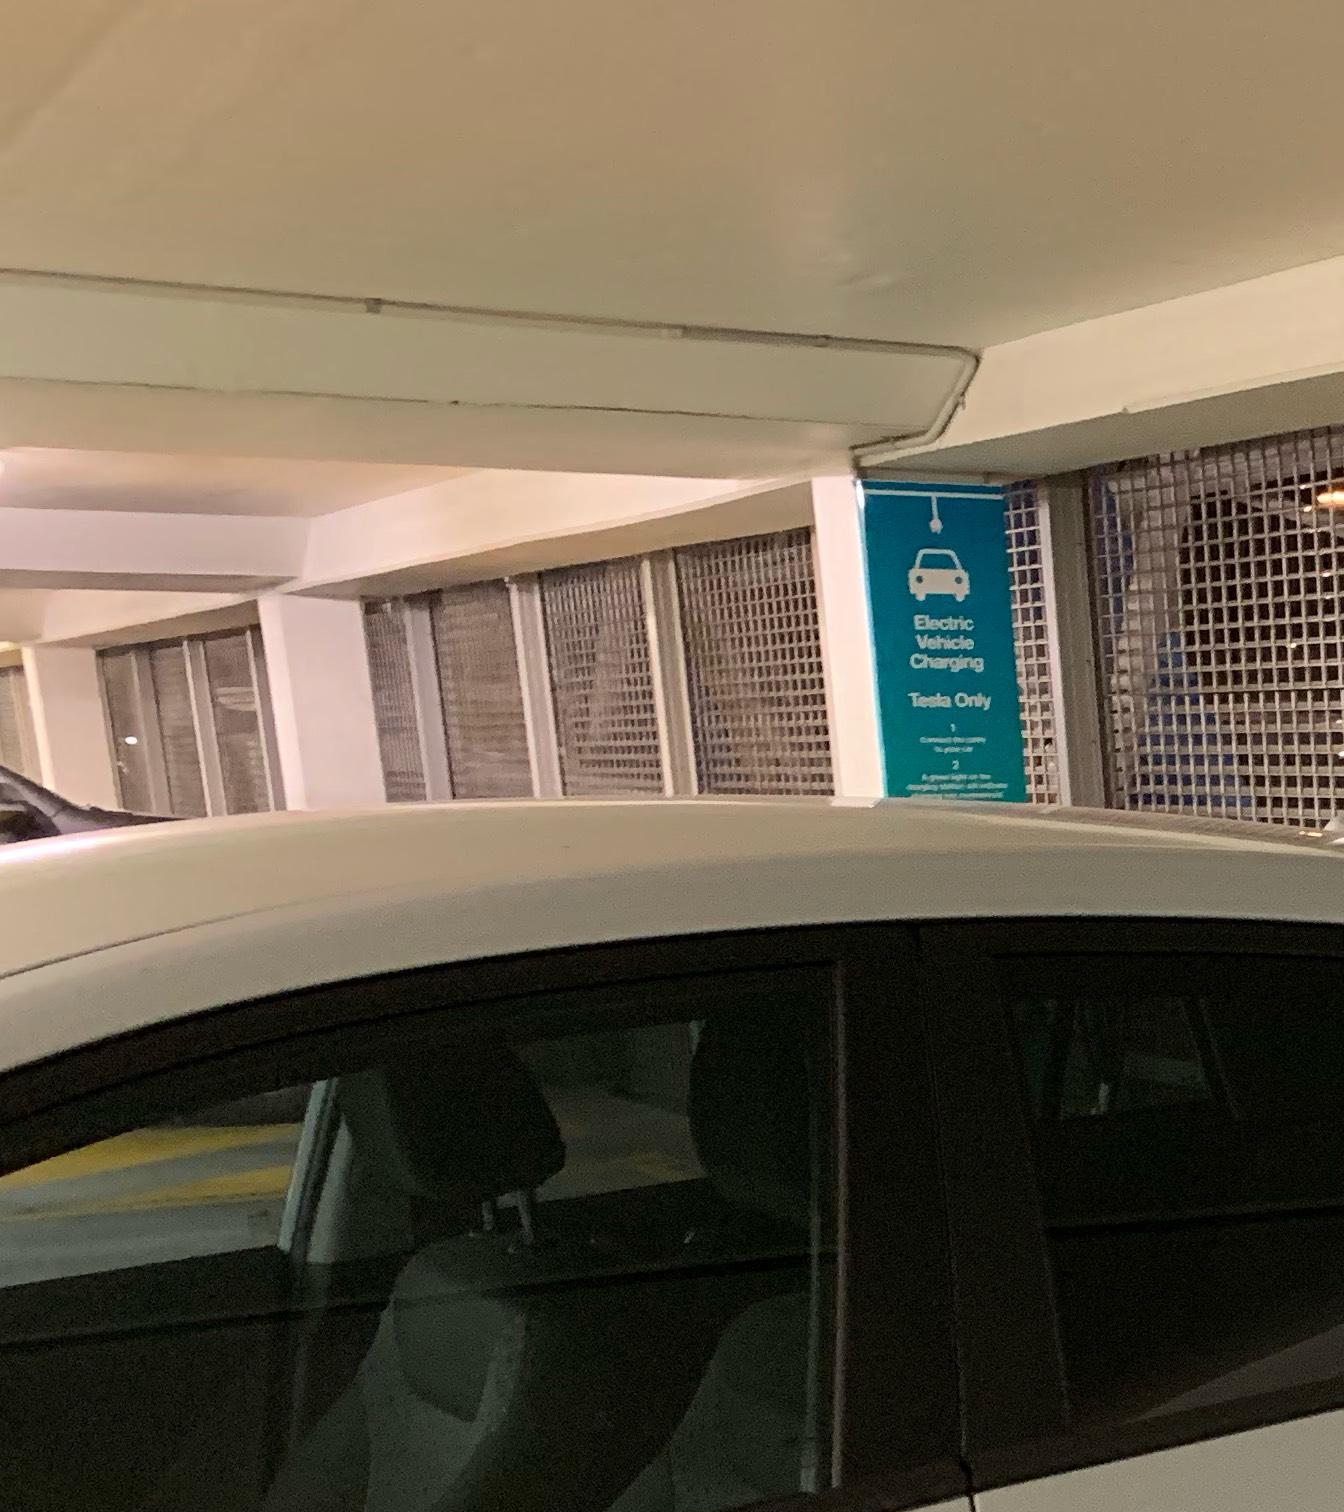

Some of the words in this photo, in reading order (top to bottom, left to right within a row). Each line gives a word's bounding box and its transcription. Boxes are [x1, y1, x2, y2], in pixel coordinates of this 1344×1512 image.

[913, 614, 975, 631] Electric
[915, 634, 975, 650] Vehicle
[909, 653, 985, 673] Charging
[908, 692, 953, 708] Tesla
[954, 692, 992, 711] Only
[950, 723, 956, 733] 1
[952, 760, 960, 770] 2
